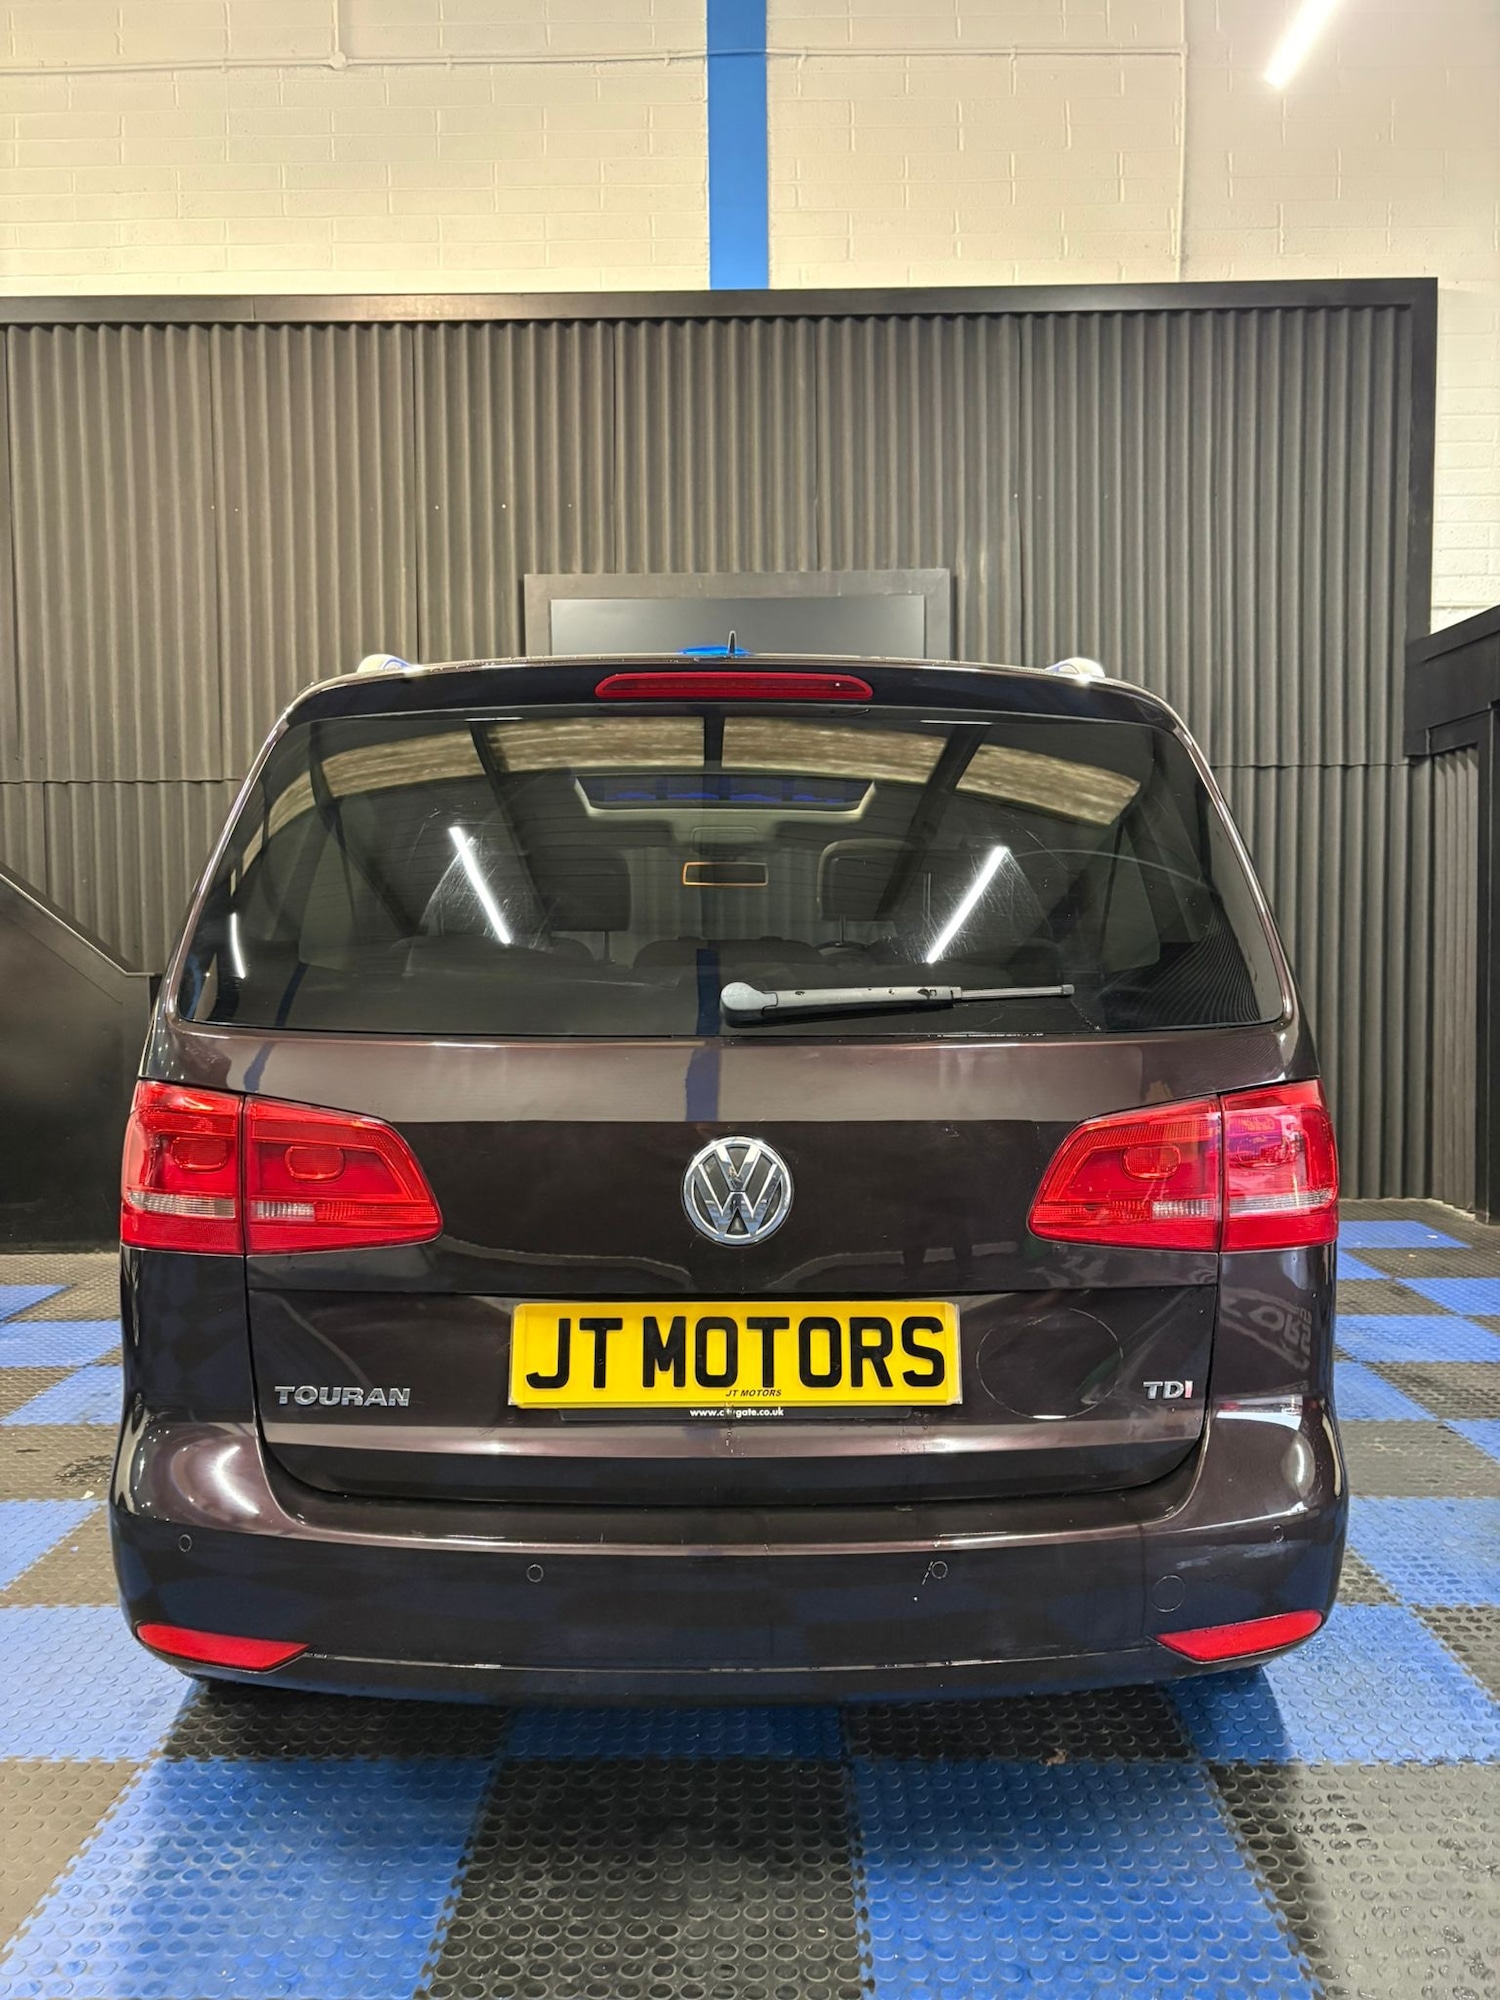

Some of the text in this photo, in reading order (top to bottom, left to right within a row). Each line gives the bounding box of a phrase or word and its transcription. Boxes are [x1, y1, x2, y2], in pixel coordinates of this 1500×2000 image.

[525, 1315, 946, 1389] JT MOTORS
[274, 1385, 411, 1407] TOURAN
[726, 1389, 782, 1397] JT MOTORS
[1143, 1381, 1193, 1399] TDI
[689, 1406, 784, 1418] www.ctgate.co.uk
